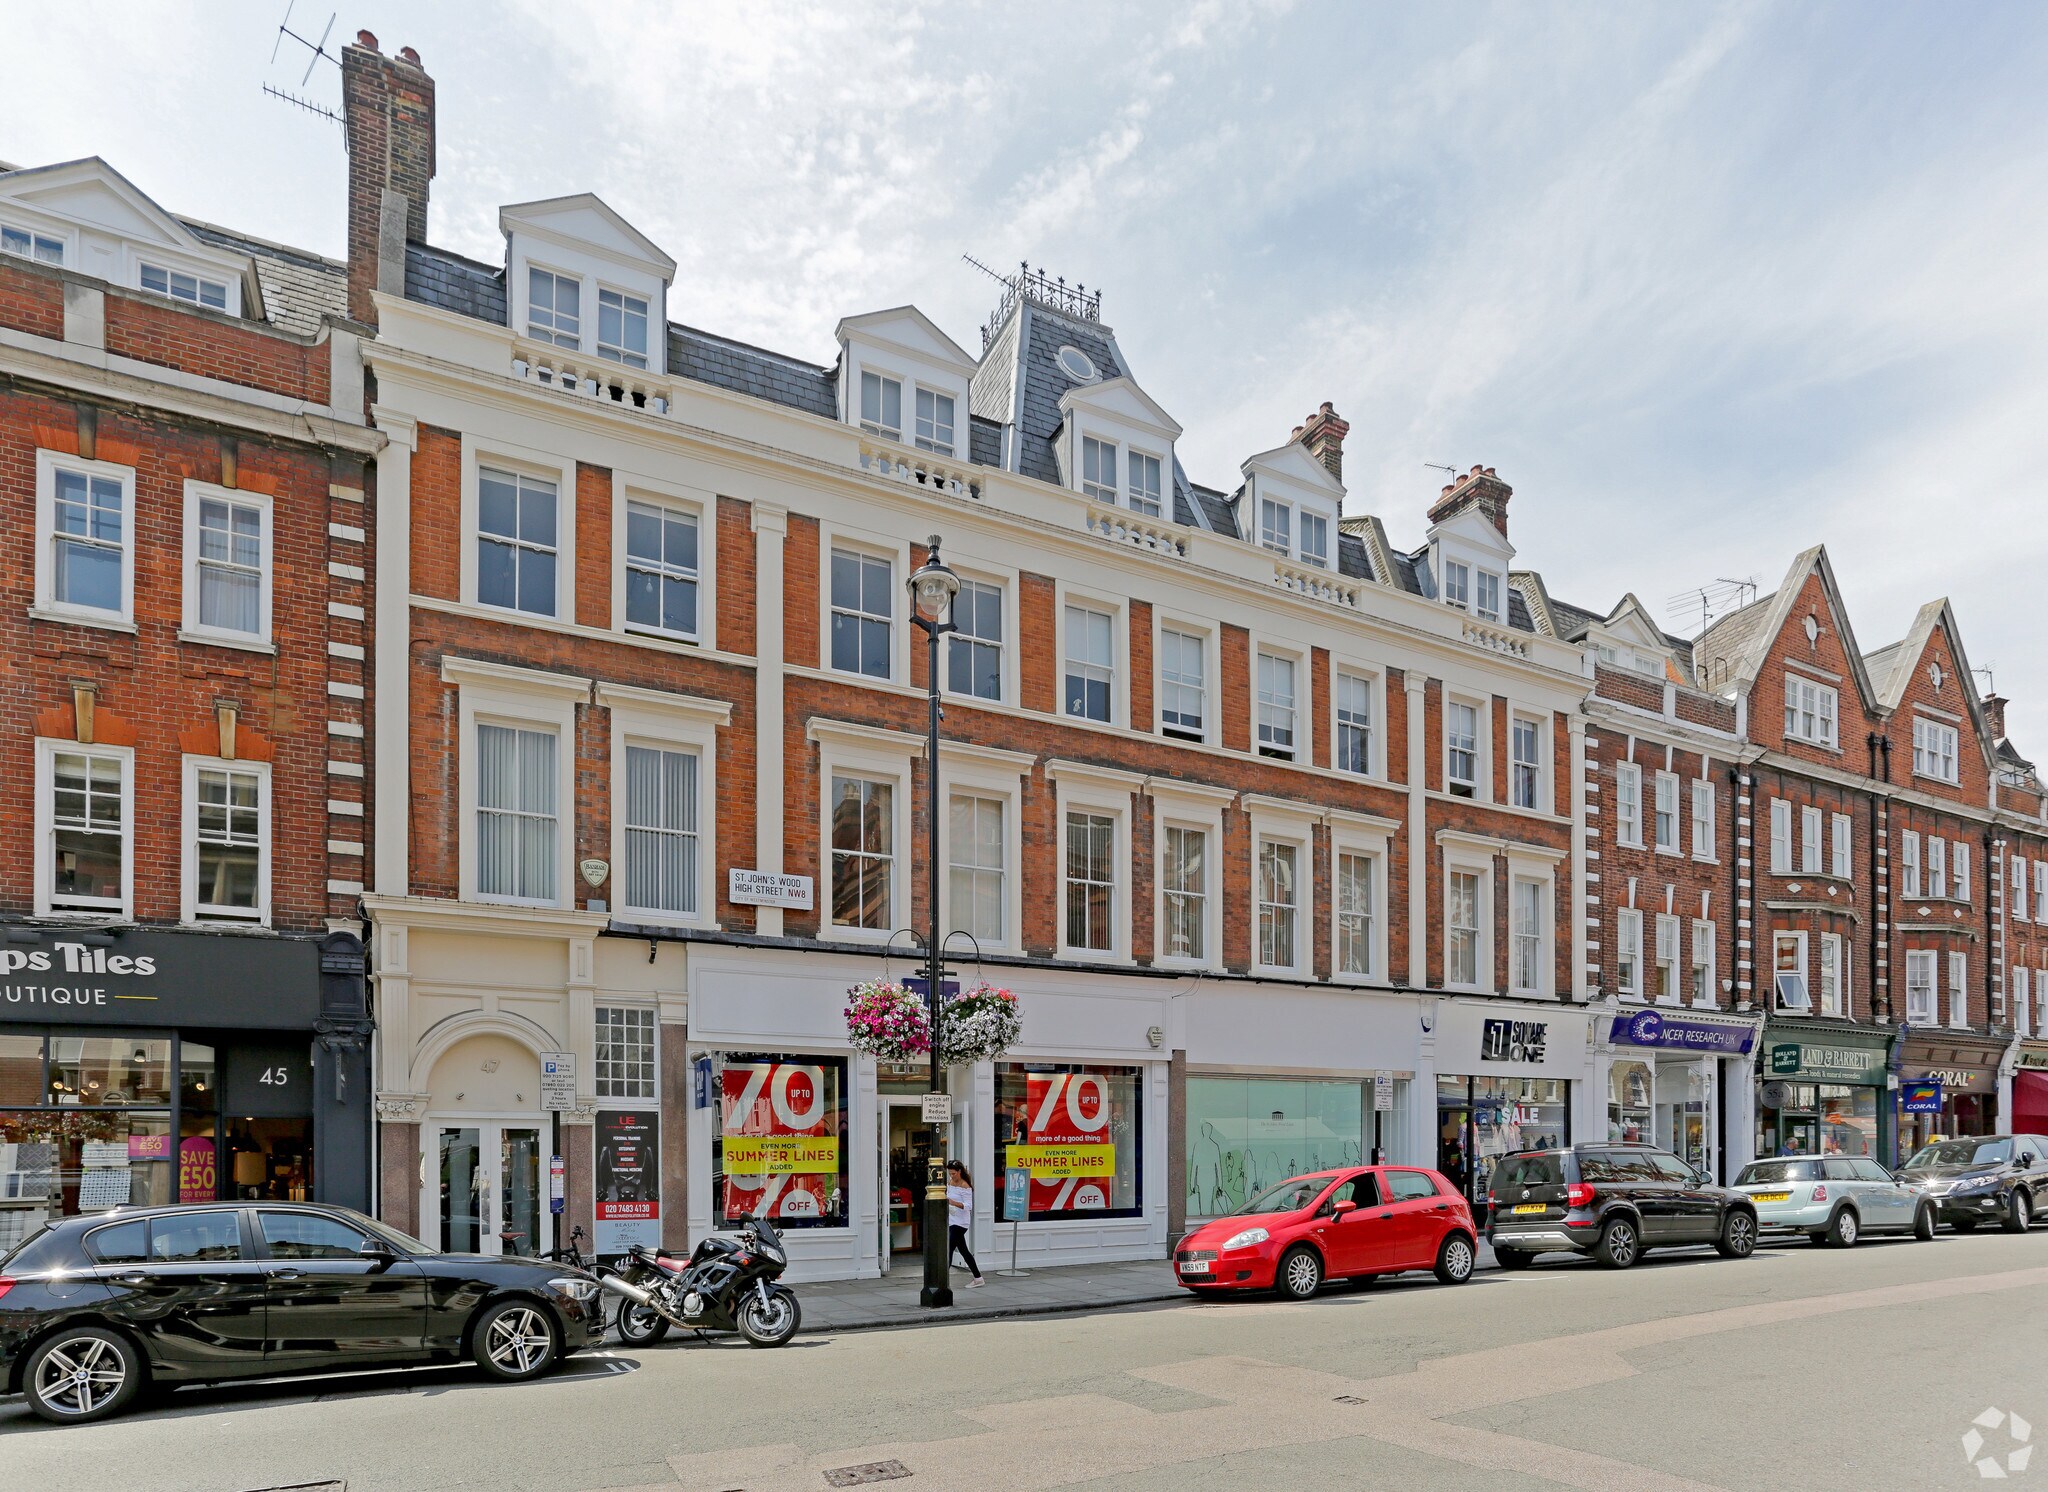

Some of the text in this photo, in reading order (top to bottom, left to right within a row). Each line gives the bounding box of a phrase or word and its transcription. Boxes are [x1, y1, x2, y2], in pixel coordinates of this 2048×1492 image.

[748, 874, 775, 885] JOHN'S
[778, 877, 801, 888] WOOD
[735, 883, 806, 898] HIGH STREET NW8
[54, 942, 156, 976] Tiles
[0, 985, 107, 1005] UTIQUE
[1512, 1021, 1548, 1046] SQUARE
[1660, 1028, 1684, 1042] NCER
[1684, 1029, 1724, 1044] RESEARCH
[1725, 1033, 1737, 1045] UK
[1510, 1045, 1546, 1064] ONE
[1774, 1050, 1797, 1058] HOLLAND
[1800, 1048, 1824, 1065] LAND
[1834, 1050, 1870, 1070] BARRETT
[259, 1066, 288, 1085] 45
[1928, 1070, 1969, 1087] CORAL
[722, 1063, 824, 1130] 70
[791, 1089, 810, 1098] UP TO
[1082, 1096, 1098, 1104] UP TO
[1028, 1073, 1108, 1133] 70
[619, 1116, 636, 1126] UE
[1502, 1107, 1539, 1124] SALE
[1068, 1134, 1084, 1143] good
[1084, 1134, 1101, 1143] thing
[180, 1150, 214, 1165] SAVE
[726, 1150, 834, 1162] SUMMER LINES
[1017, 1156, 1104, 1168] SUMMER LINES
[180, 1166, 216, 1190] £50
[788, 1201, 811, 1212] OFF
[1080, 1195, 1099, 1204] OFF
[606, 1204, 650, 1213] 020 7483 4130
